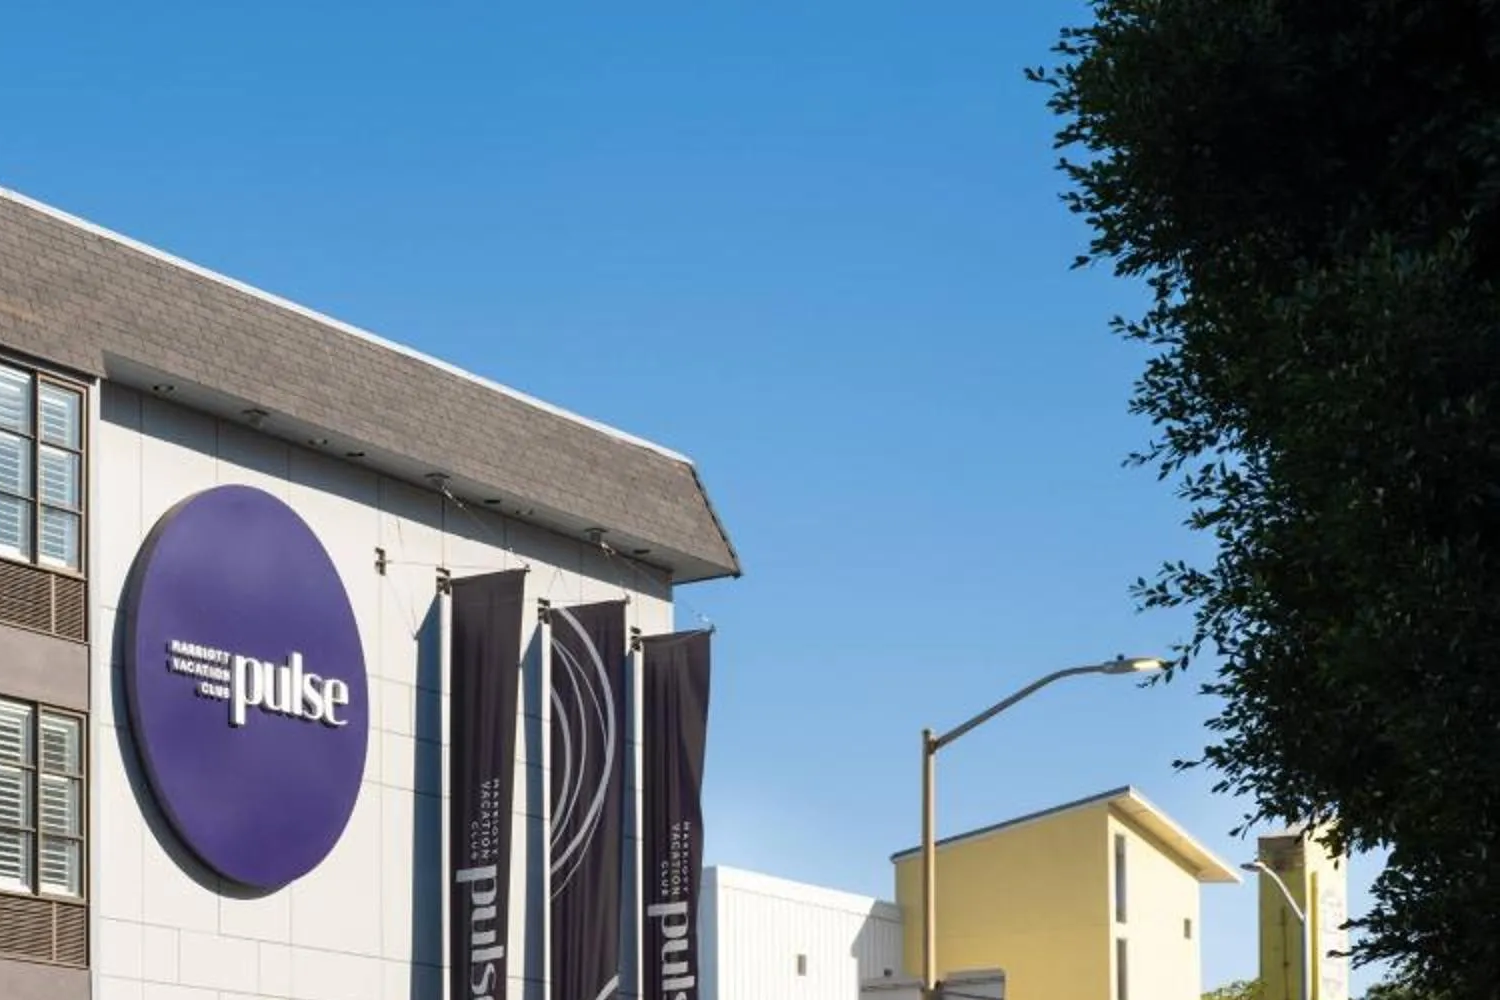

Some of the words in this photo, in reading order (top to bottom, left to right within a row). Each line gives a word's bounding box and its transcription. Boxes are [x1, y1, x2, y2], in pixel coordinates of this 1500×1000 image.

[171, 640, 231, 664] MARRIOTT
[172, 657, 231, 681] VACATION
[201, 681, 231, 699] CLUB
[235, 652, 349, 725] pulse
[470, 821, 479, 860] CLUB
[480, 781, 491, 859] VACATION
[492, 778, 500, 855] MARRIOTT
[661, 860, 669, 896] CLUB
[671, 823, 681, 896] VACATION
[681, 821, 691, 894] MARRIOTT
